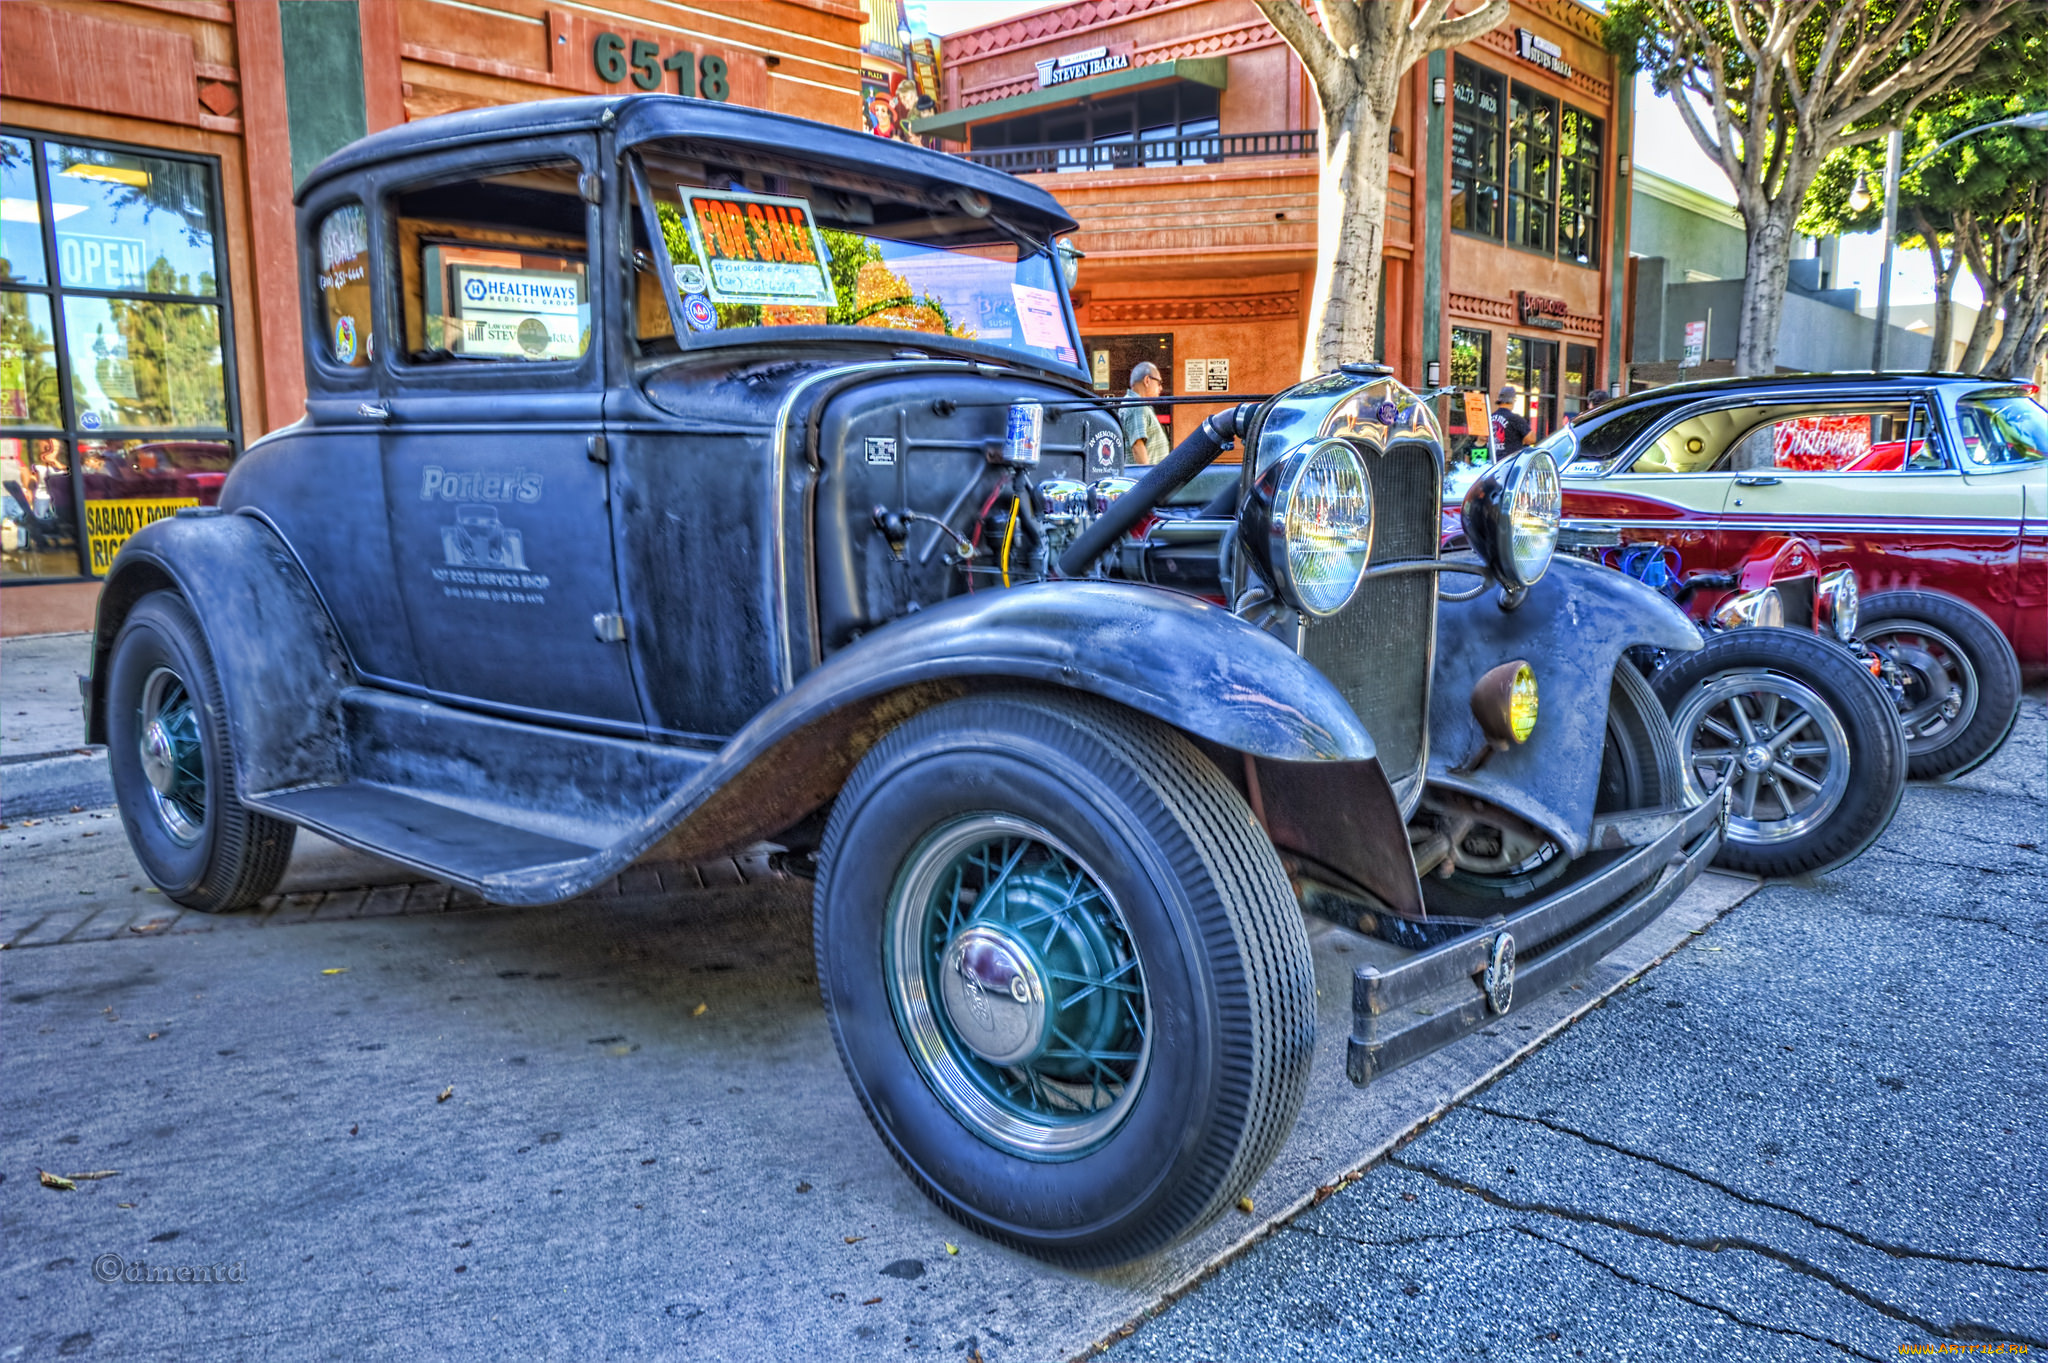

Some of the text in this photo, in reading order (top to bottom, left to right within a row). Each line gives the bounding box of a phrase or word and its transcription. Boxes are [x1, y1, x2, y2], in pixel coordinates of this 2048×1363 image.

[593, 32, 730, 101] 6518
[1053, 53, 1128, 84] STEVEN IBARRA
[693, 197, 816, 262] FOR SALE
[61, 238, 142, 286] OPEN
[488, 281, 575, 300] HEALTHWAYS
[489, 296, 535, 305] MEDICAL
[488, 330, 518, 341] STEV
[1097, 354, 1106, 364] A
[420, 465, 544, 503] Porter's
[87, 504, 196, 536] SABADO Y DOMI
[93, 539, 126, 567] RIC
